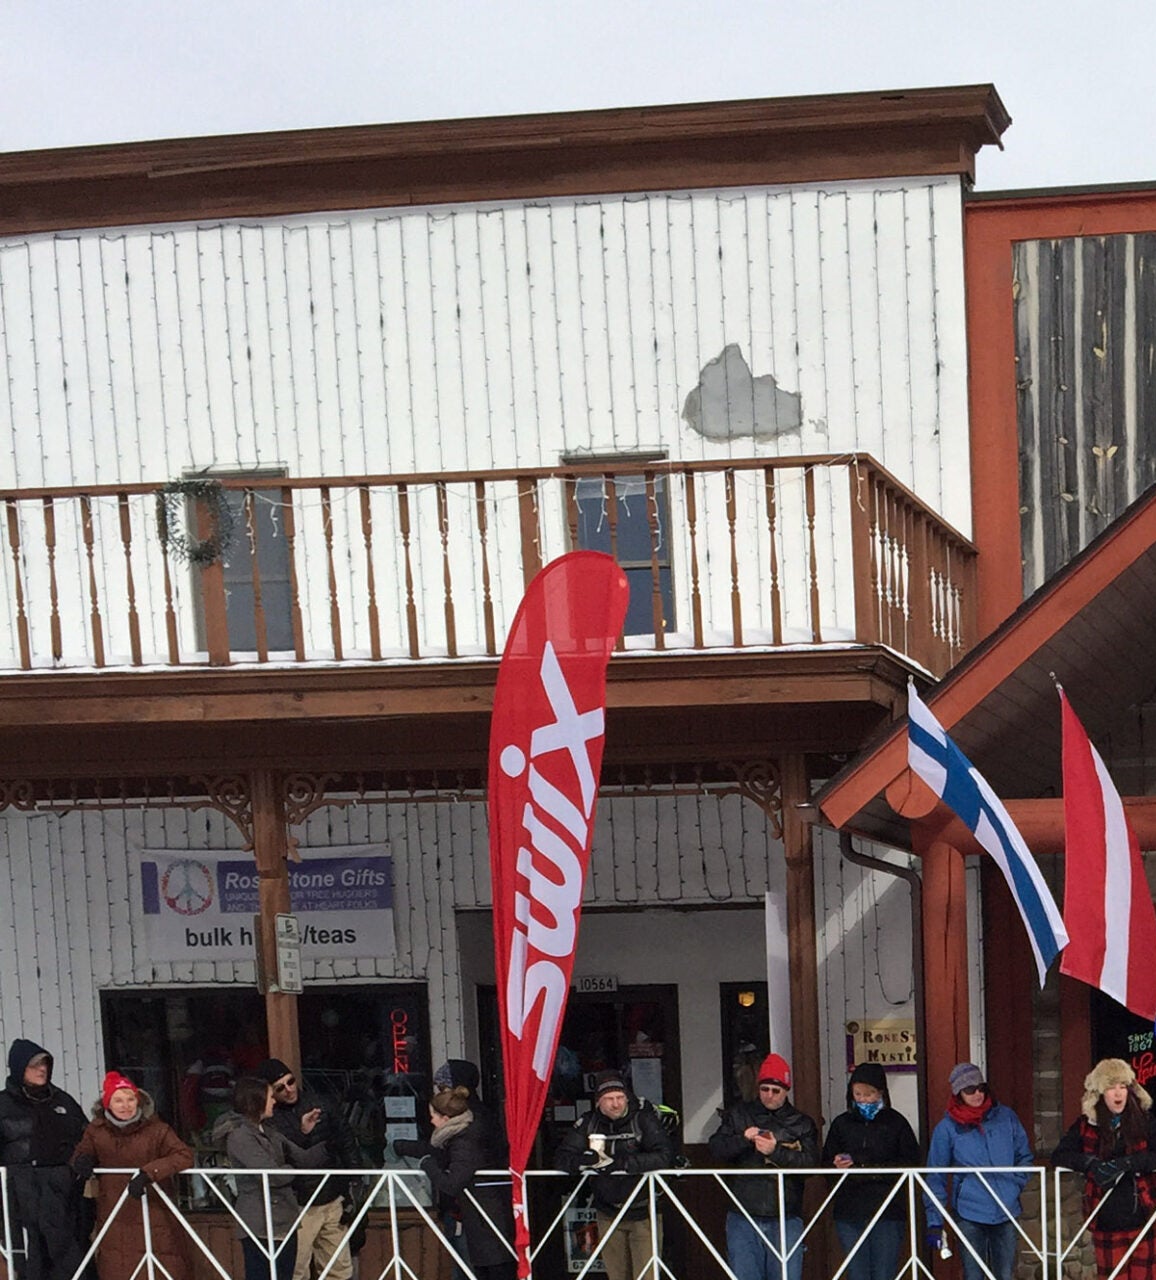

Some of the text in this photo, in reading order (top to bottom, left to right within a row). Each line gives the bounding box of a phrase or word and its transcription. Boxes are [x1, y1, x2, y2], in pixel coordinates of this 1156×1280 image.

[341, 869, 386, 886] Gifts
[186, 927, 233, 947] bulk
[580, 978, 614, 990] 10564
[390, 1008, 409, 1074] OPEN
[1129, 1040, 1153, 1053] 1867
